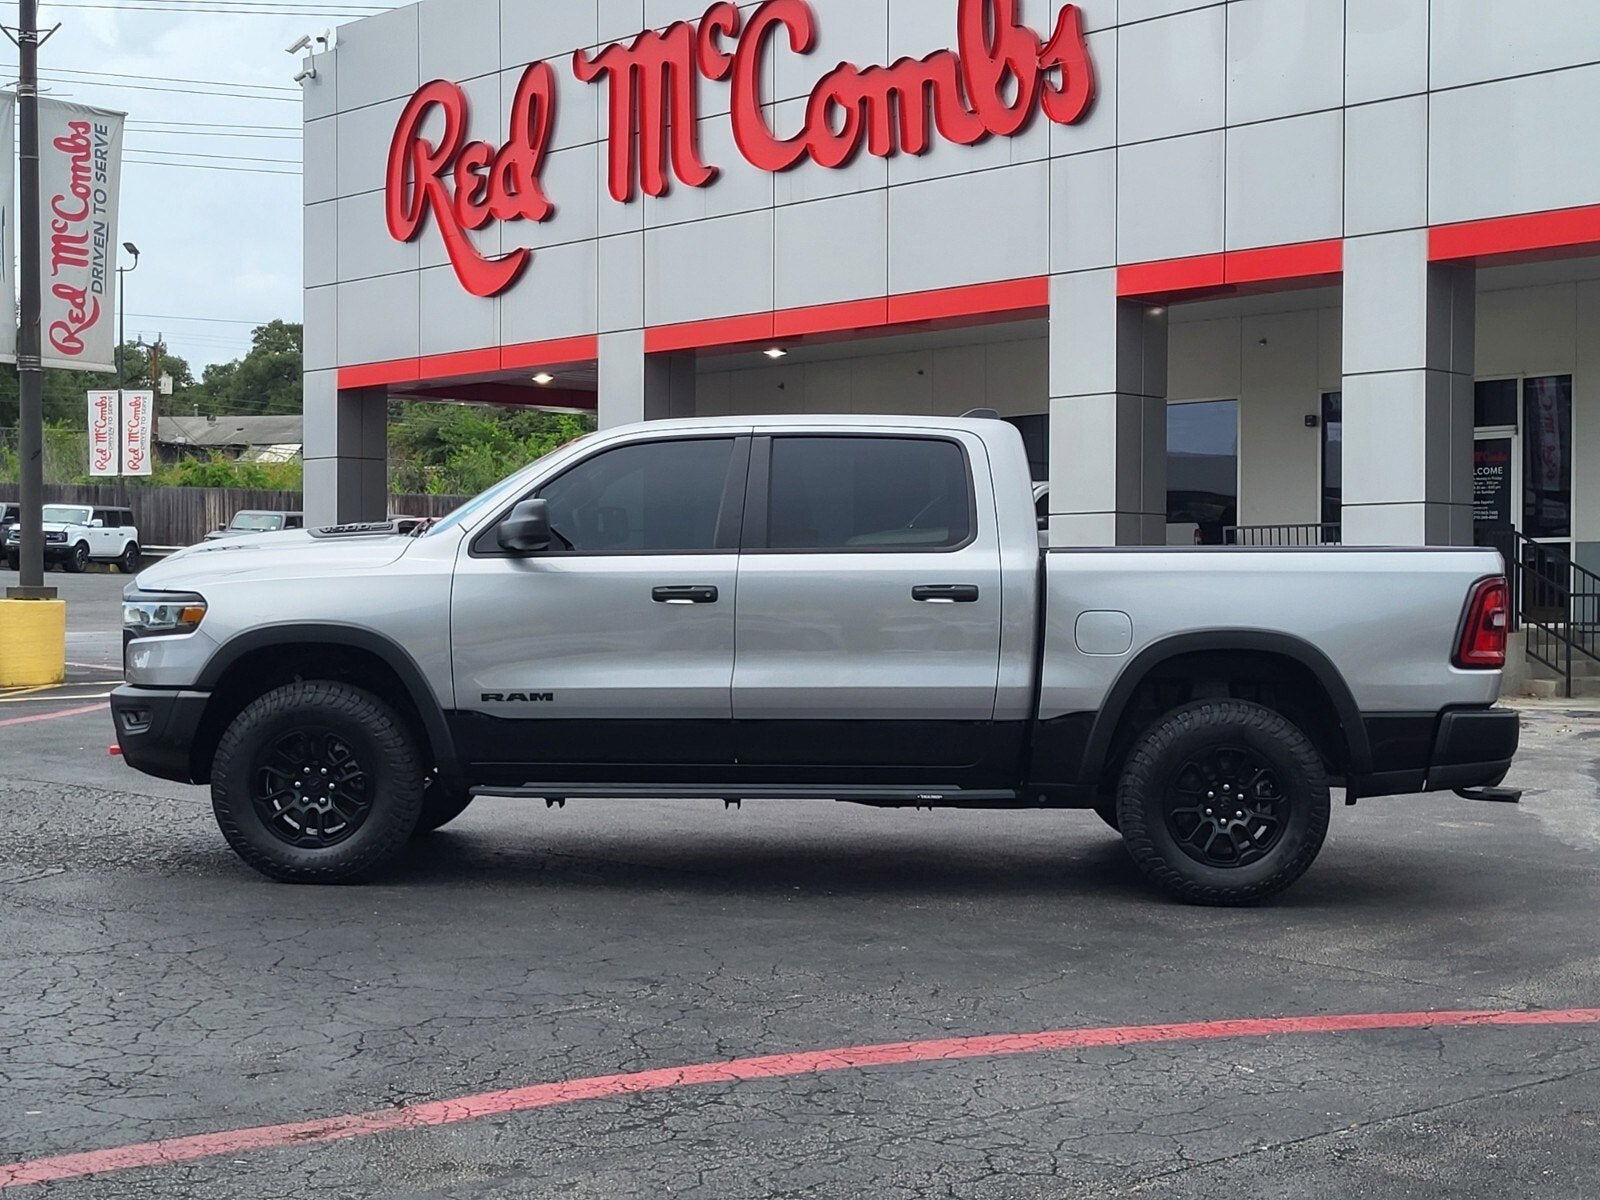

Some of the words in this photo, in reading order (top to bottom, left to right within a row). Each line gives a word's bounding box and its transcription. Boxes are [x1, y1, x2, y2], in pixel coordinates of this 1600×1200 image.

[94, 122, 109, 184] SERVE
[386, 60, 556, 298] Red
[573, 0, 1097, 203] McCombs
[51, 121, 92, 275] McCombs
[93, 188, 107, 215] TO
[91, 220, 105, 295] DRIVEN
[49, 283, 100, 355] Red
[95, 396, 107, 447] McCombs
[128, 396, 141, 446] McCombs
[95, 448, 111, 470] Red
[128, 448, 144, 470] Red
[481, 692, 554, 702] RAM
